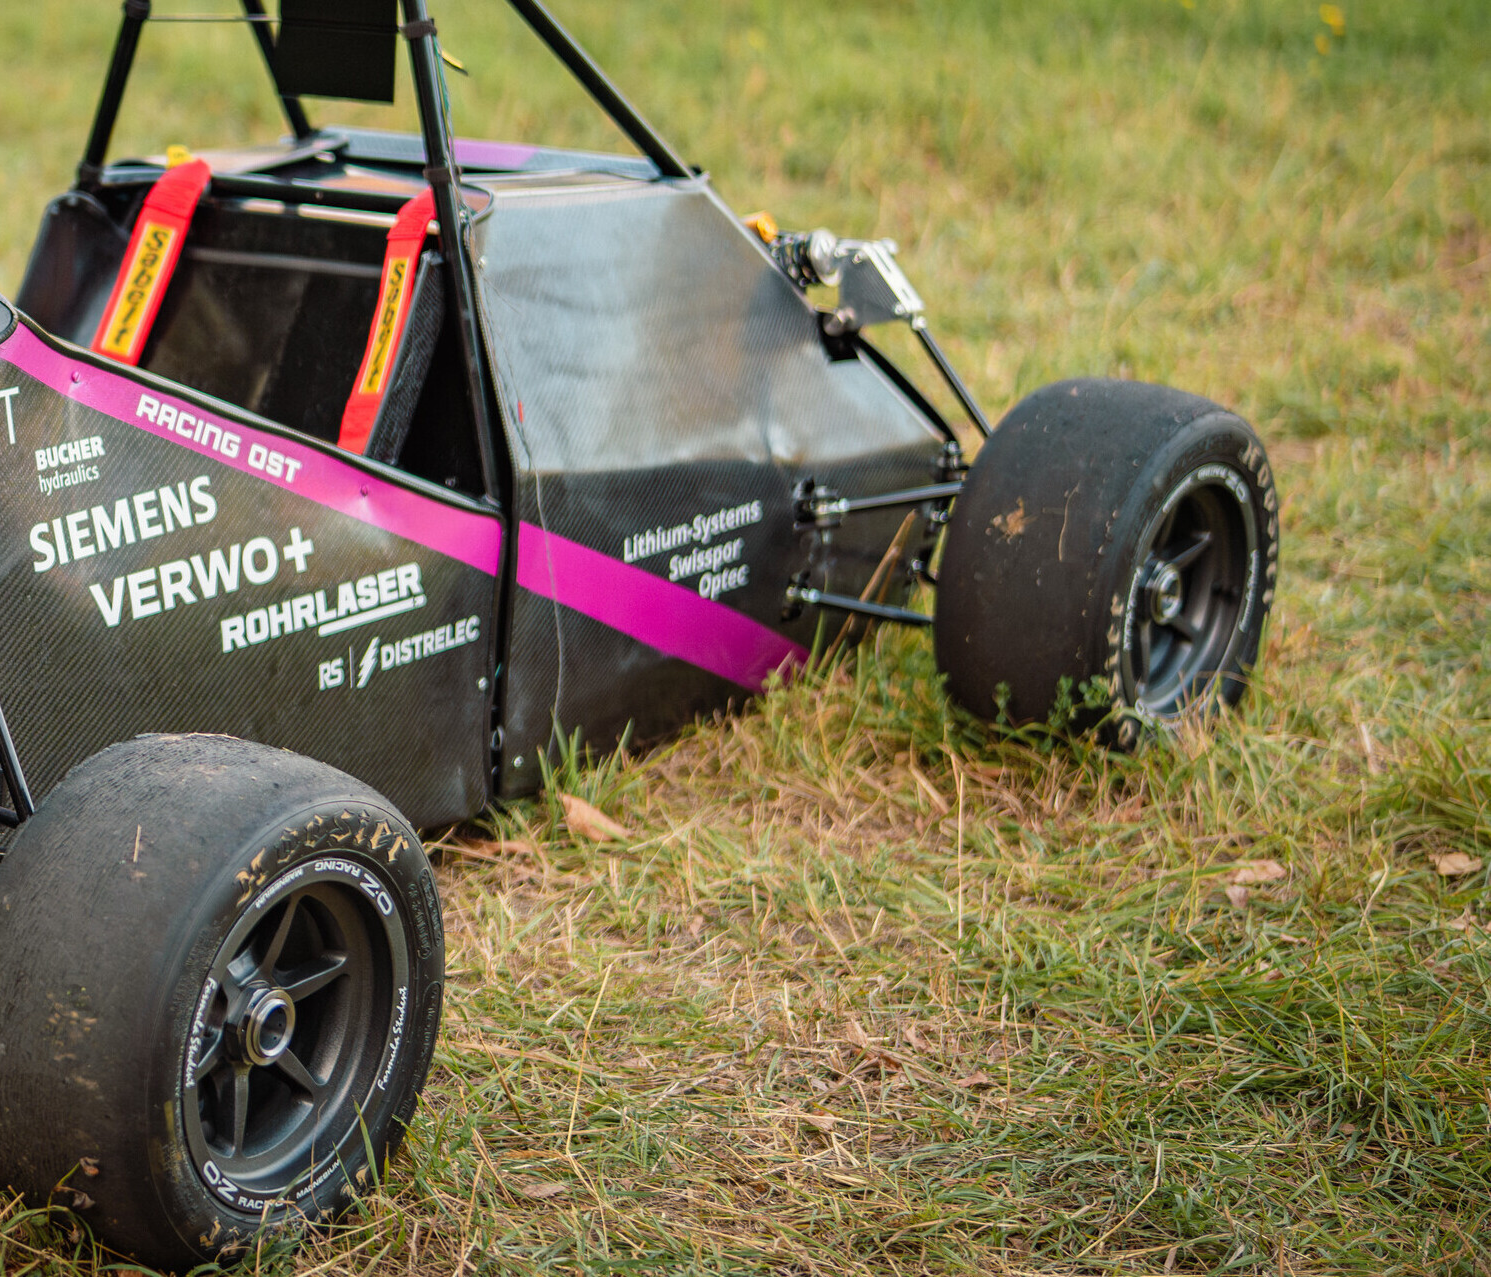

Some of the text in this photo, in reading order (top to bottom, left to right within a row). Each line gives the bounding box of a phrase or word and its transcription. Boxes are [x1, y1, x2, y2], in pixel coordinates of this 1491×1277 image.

[114, 231, 168, 345] Sabelt
[368, 263, 405, 387] Sabelt
[35, 436, 106, 471] BUCHER
[136, 393, 302, 483] RACING OST
[38, 464, 100, 496] hydraulics
[29, 475, 218, 573] SIEMENS
[624, 500, 763, 563] Lithium-Systems
[669, 537, 744, 582] Swisspor
[220, 562, 424, 653] ROHRLASER
[698, 564, 750, 601] Optec
[319, 615, 481, 691] RS DISTRELEC
[255, 868, 304, 909] MAGNESIUM
[314, 859, 361, 878] RACING
[185, 977, 218, 1088] Formula Student
[377, 985, 408, 1091] Formula Student
